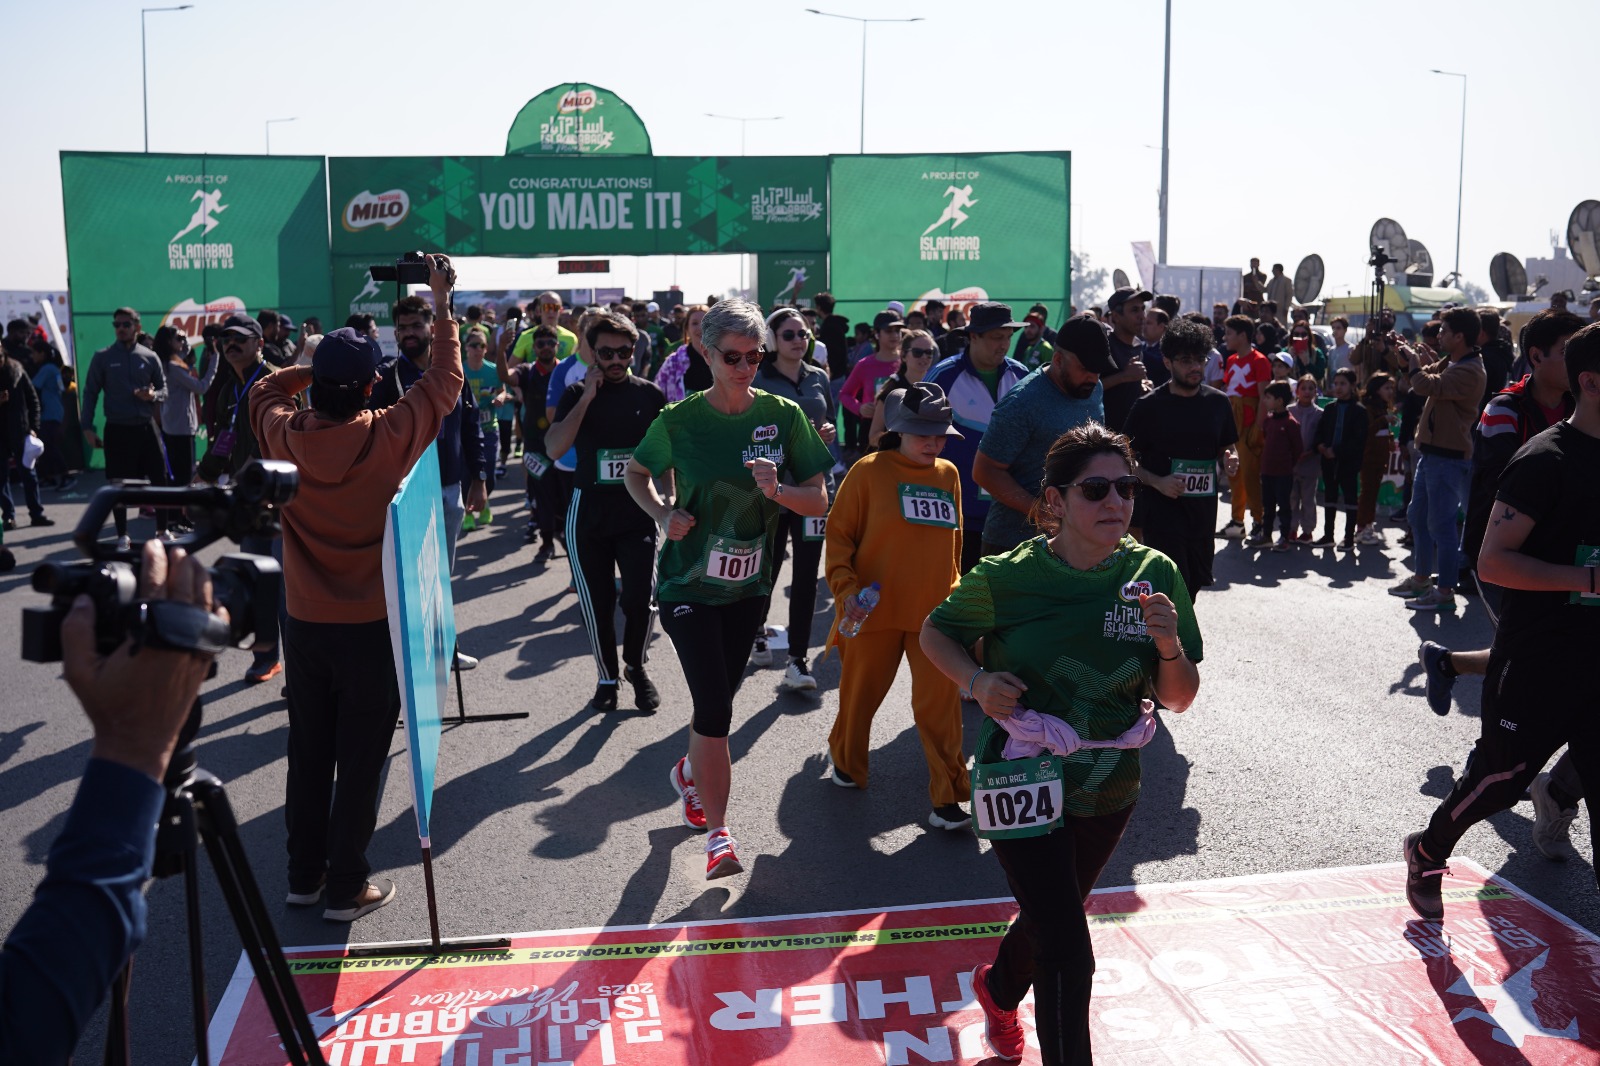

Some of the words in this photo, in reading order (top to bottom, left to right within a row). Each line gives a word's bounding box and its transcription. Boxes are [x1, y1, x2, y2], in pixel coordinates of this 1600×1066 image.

[562, 97, 592, 107] MILO
[165, 175, 173, 183] A
[174, 174, 213, 184] PROJECT
[215, 174, 228, 184] OF
[509, 177, 653, 190] CONGRATULATIONS!
[921, 172, 928, 180] A
[930, 171, 966, 180] PROJECT
[968, 171, 980, 179] OF
[351, 201, 404, 222] MILO
[479, 191, 535, 230] YOU
[548, 191, 634, 230] MADE
[645, 191, 682, 230] IT!
[168, 243, 233, 259] ISLAMABAD
[920, 236, 980, 250] ISLAMABAD
[169, 259, 190, 270] RUN
[193, 258, 218, 269] WITH
[221, 258, 234, 268] US
[920, 251, 939, 261] RUN
[942, 251, 964, 261] WITH
[968, 251, 981, 261] US
[755, 429, 776, 439] MILO
[608, 462, 629, 478] 12
[1183, 475, 1210, 492] 046
[911, 499, 951, 520] 1318
[719, 553, 757, 578] 1011
[987, 778, 994, 786] 10
[995, 776, 1008, 786] KM
[1009, 772, 1028, 783] RACE
[982, 786, 1055, 827] 1024
[529, 932, 877, 961] #MILOISLAMABADMARATHON2025
[287, 951, 515, 971] #MILOISLAMABADMA
[597, 982, 654, 997] 2025
[709, 943, 1300, 1030] TOGTHER
[410, 980, 580, 1013] Marathon
